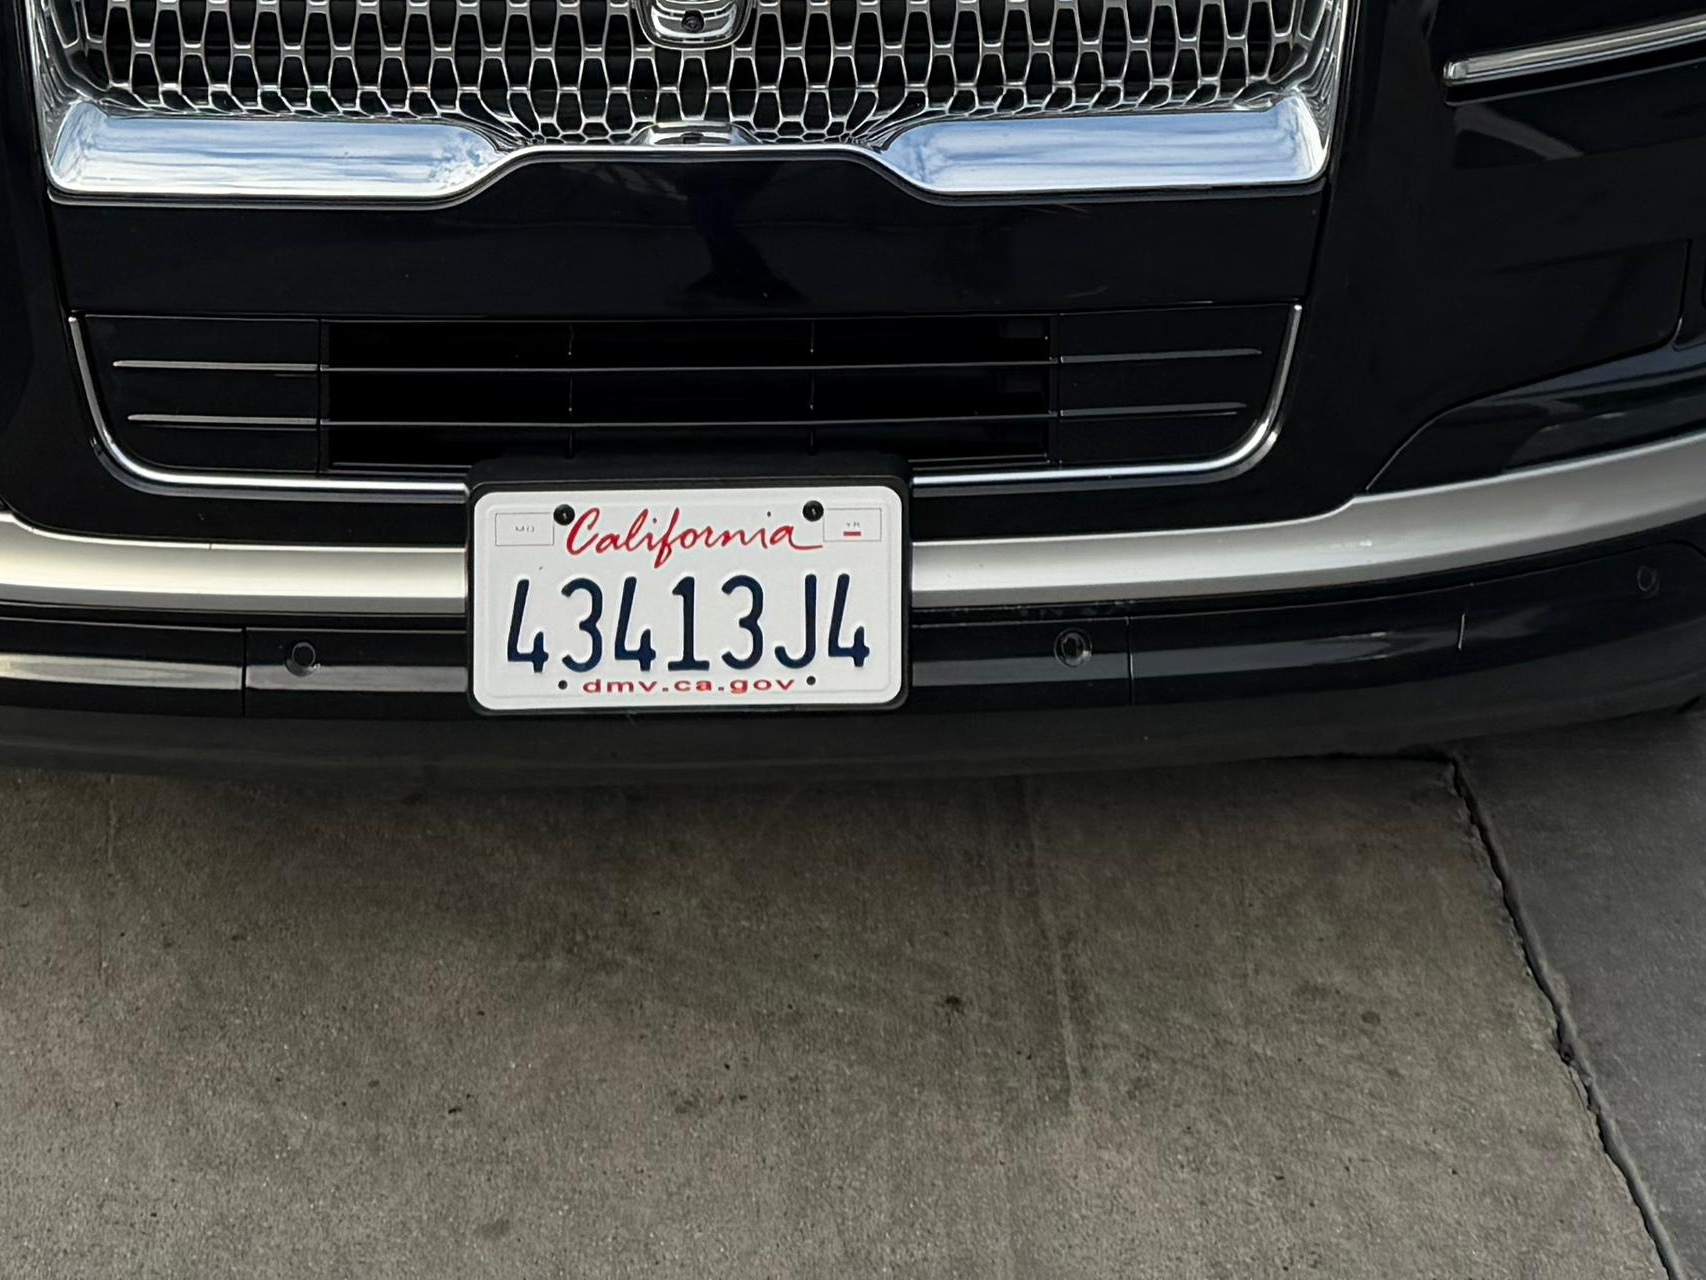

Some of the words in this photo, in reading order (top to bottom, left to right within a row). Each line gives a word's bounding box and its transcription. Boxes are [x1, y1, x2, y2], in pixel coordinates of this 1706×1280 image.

[566, 507, 823, 569] California
[506, 573, 871, 673] 43413J4
[582, 676, 796, 695] dmv.ca.gov
